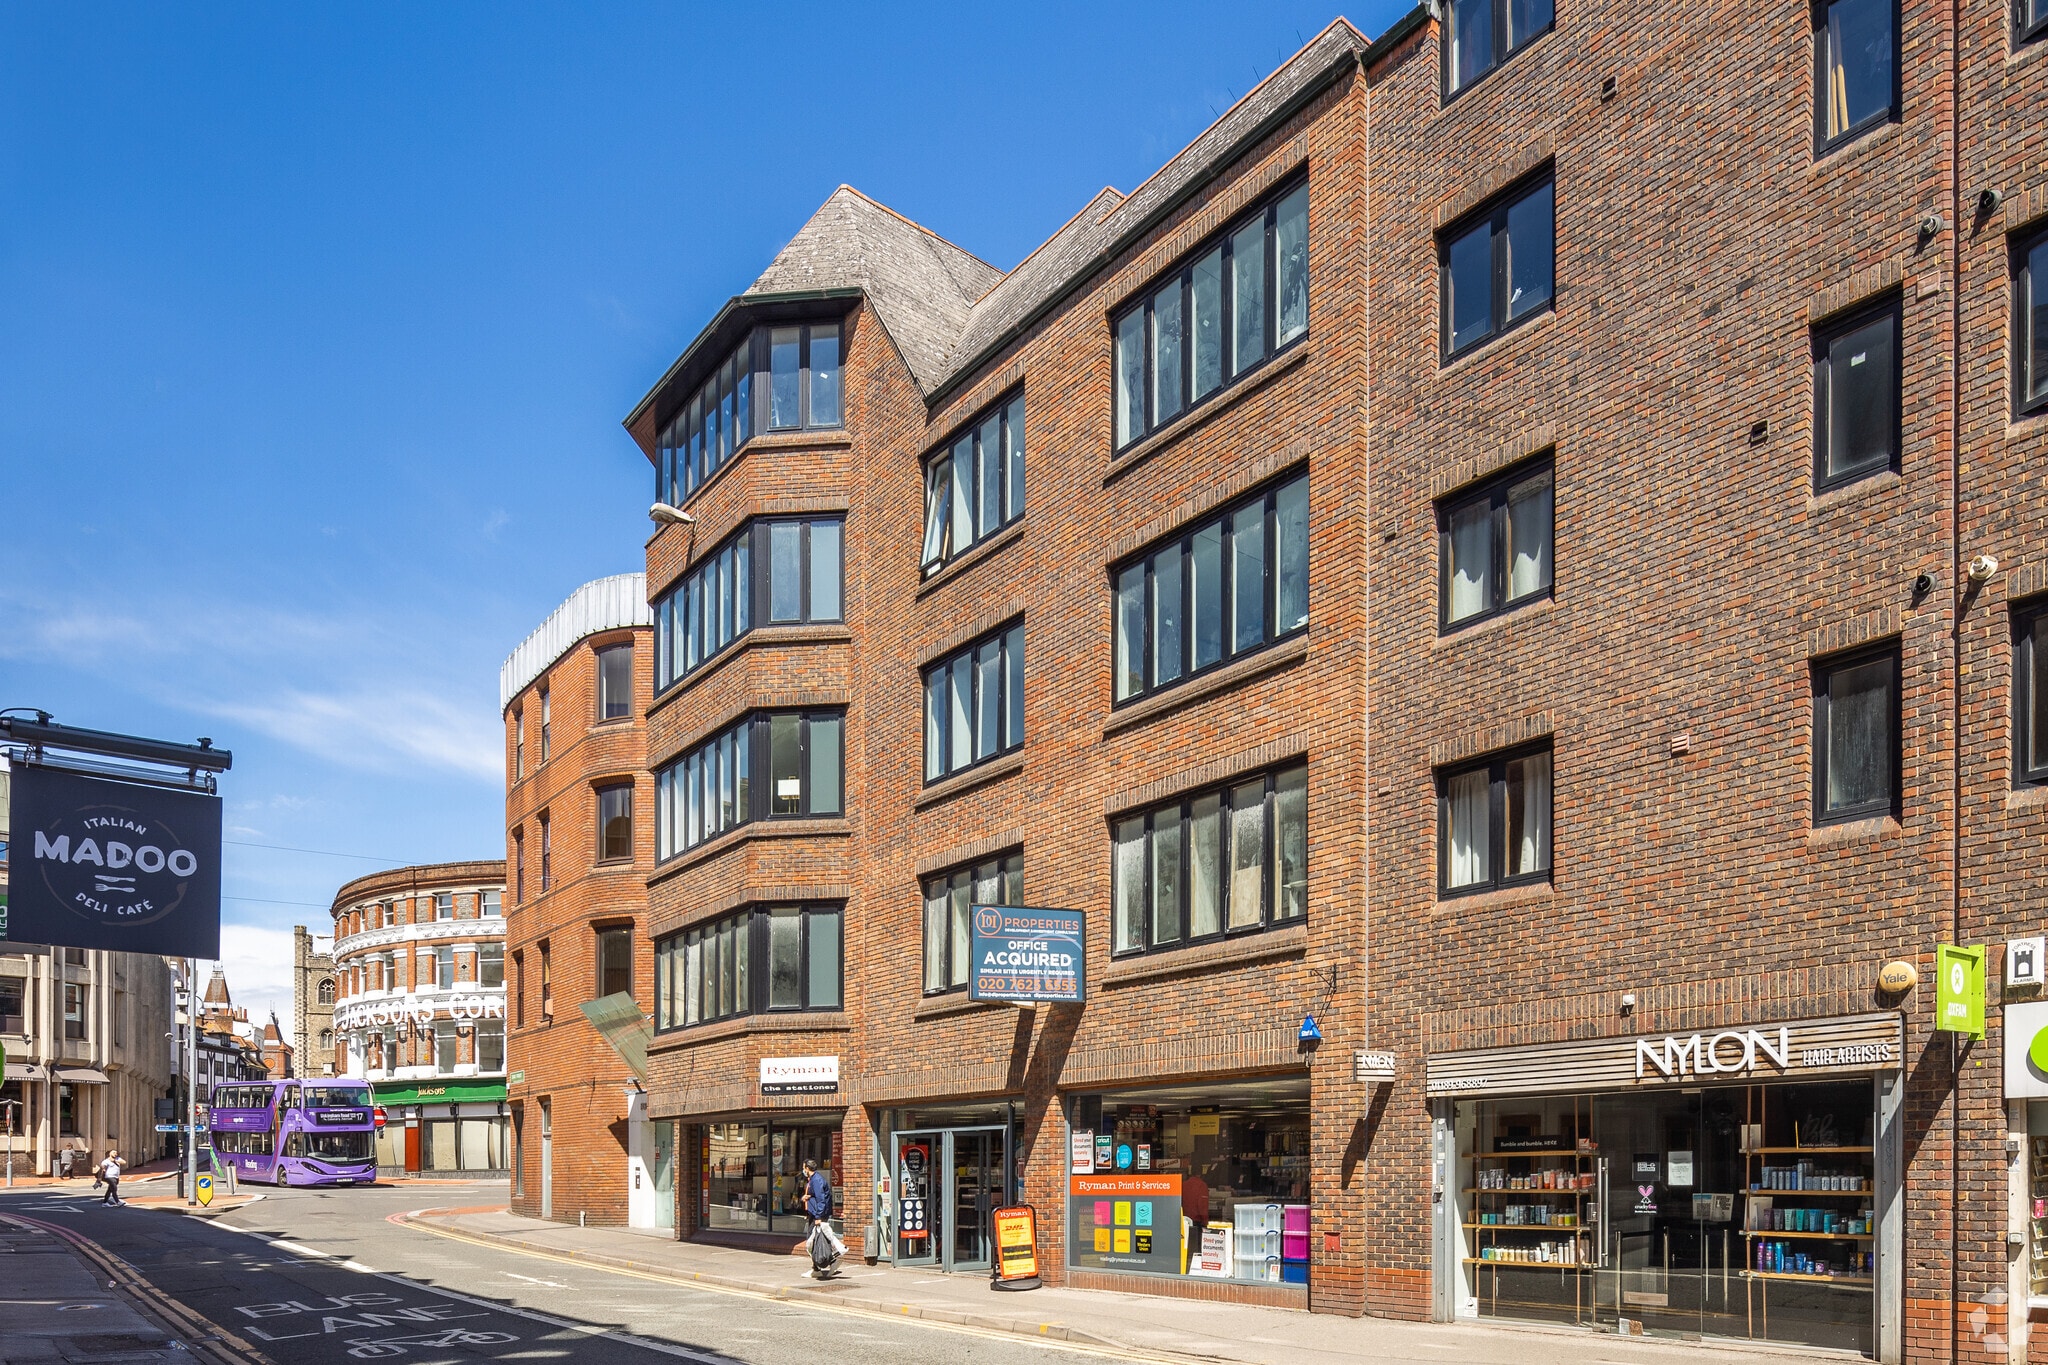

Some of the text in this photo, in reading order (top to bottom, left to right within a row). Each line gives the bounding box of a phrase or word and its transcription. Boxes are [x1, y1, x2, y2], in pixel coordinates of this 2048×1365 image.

[83, 816, 147, 836] ITALIAN
[34, 830, 198, 877] MADOO
[75, 892, 108, 913] DELI
[1004, 917, 1079, 930] PROPERTIES
[1008, 940, 1048, 951] OFFICE
[2011, 942, 2037, 952] FORTRESS
[983, 951, 1072, 967] ACQUIRED
[978, 978, 1005, 990] 020
[1883, 973, 1908, 984] Yale
[341, 994, 505, 1030] JACKSONS COR
[1948, 1002, 1967, 1018] OXFAM
[1636, 1027, 1890, 1079] NYLON HAIR ARTISTS
[767, 1066, 833, 1076] Ryman
[786, 1084, 837, 1092] stationer
[356, 1112, 364, 1121] 17
[1078, 1181, 1116, 1191] Ryman
[1118, 1181, 1135, 1190] Print
[1142, 1181, 1171, 1190] Services
[233, 1292, 403, 1319] BUS
[243, 1303, 490, 1341] LANE
